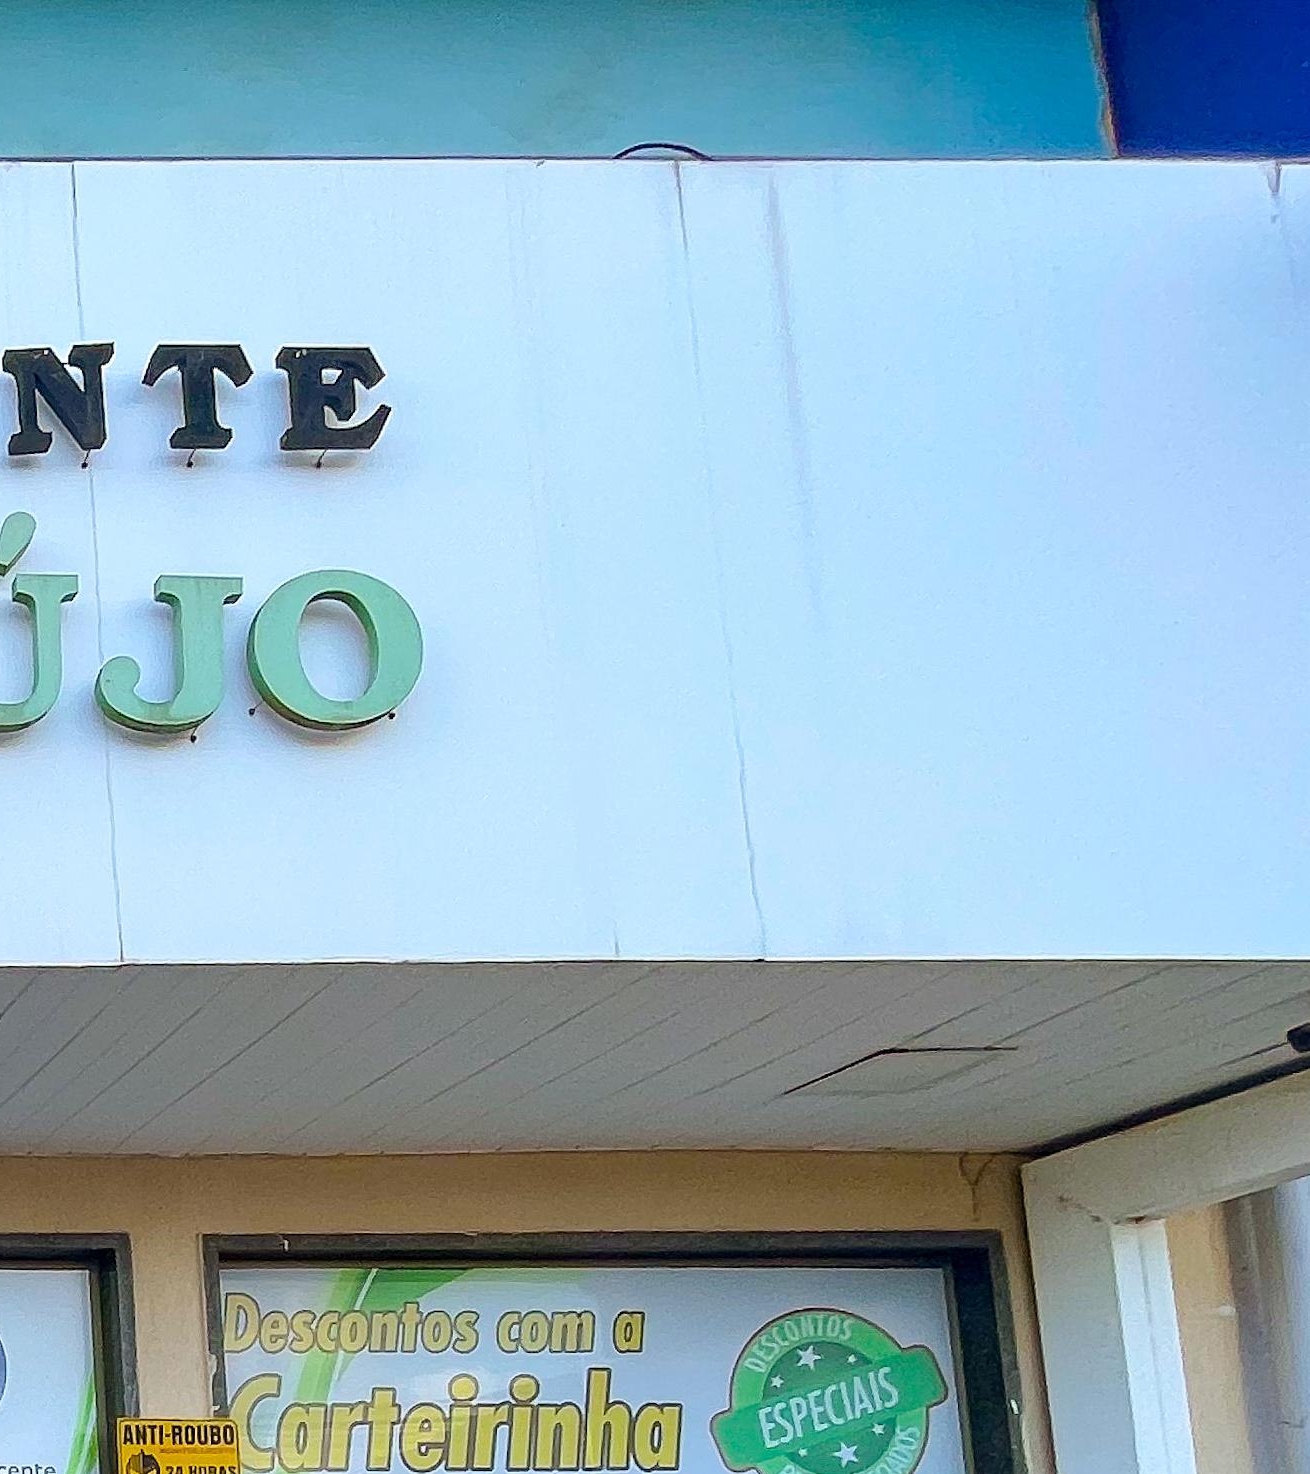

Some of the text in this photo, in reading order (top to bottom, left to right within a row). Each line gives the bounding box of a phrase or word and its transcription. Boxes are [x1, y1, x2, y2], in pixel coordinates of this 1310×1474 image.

[224, 1292, 645, 1354] Descontos com a
[743, 1313, 856, 1373] DESCONTOS
[123, 1424, 235, 1445] ANTI-ROUBO
[228, 1367, 683, 1474] Carteirinha
[757, 1366, 899, 1449] ESPECIAIS
